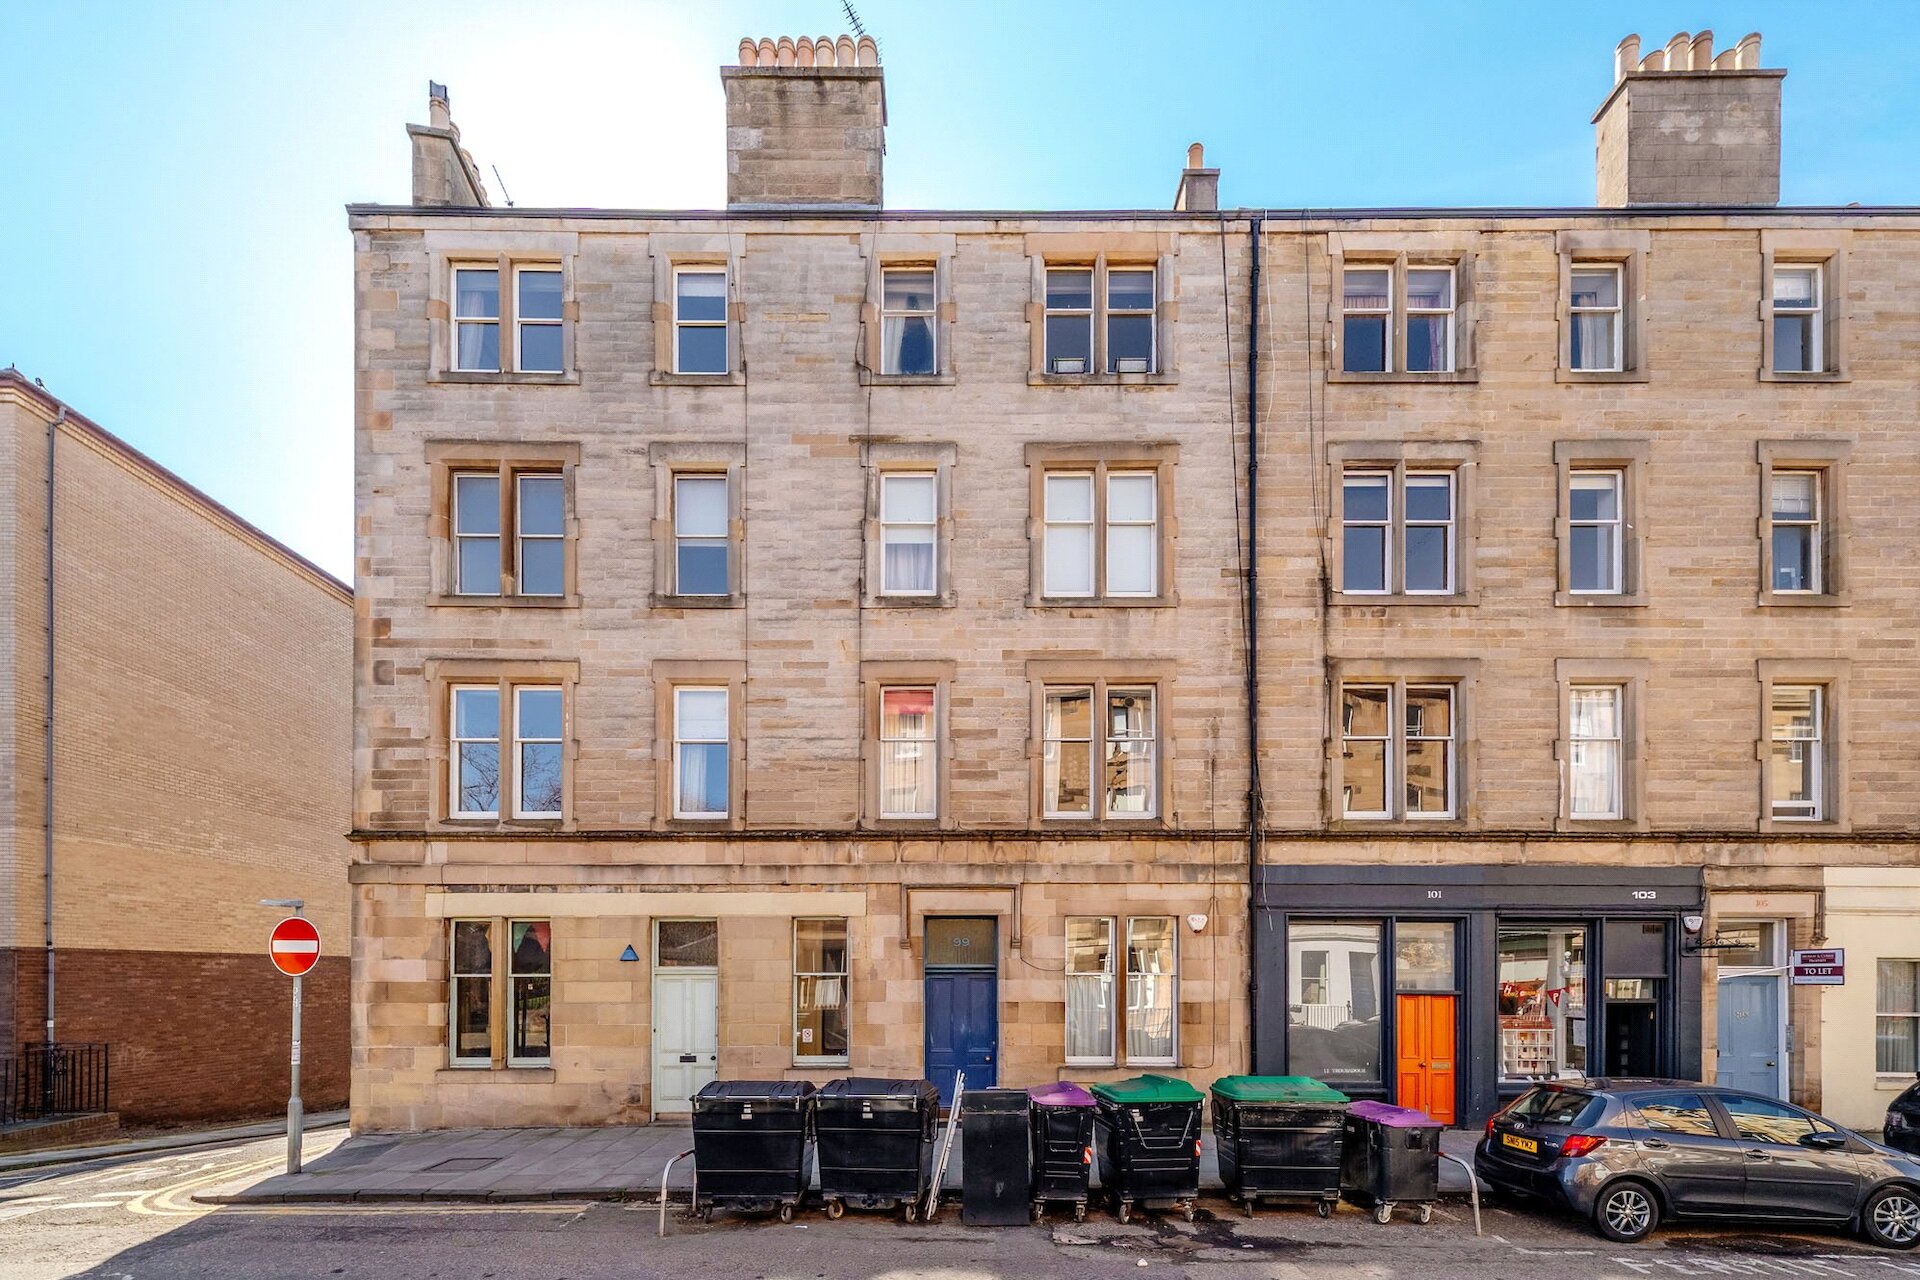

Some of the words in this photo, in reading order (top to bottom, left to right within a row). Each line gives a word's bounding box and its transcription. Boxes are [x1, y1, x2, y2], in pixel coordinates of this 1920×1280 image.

[1427, 890, 1442, 899] 101
[1631, 890, 1657, 900] 103
[953, 937, 970, 947] 99
